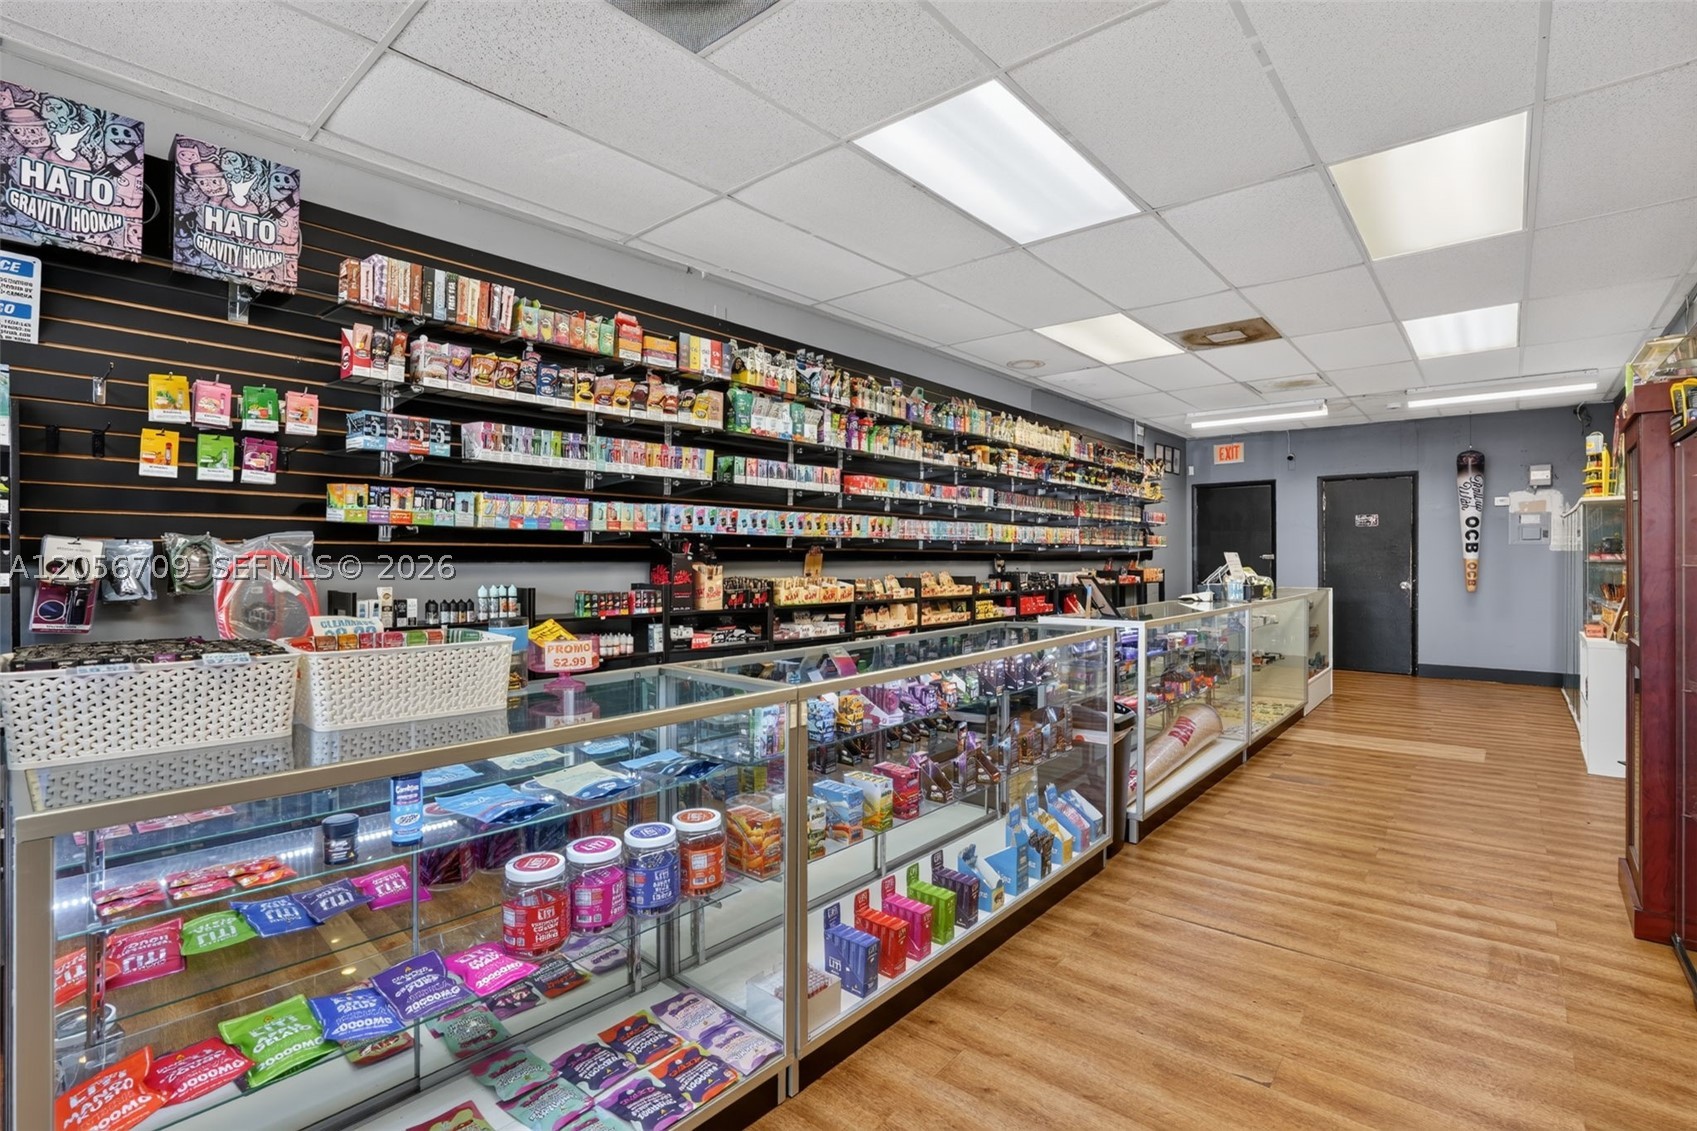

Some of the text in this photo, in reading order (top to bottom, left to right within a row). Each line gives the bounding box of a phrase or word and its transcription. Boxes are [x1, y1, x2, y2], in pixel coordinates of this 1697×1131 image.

[19, 158, 114, 205] HATO
[9, 190, 122, 234] GRAVITY HOOKAH
[204, 206, 277, 244] HATO
[195, 233, 283, 270] GRAVITY HOOKAH
[1219, 445, 1240, 461] EXIT
[1465, 516, 1480, 553] OCB
[1467, 562, 1477, 586] OCB
[547, 643, 591, 655] PROMO
[553, 656, 587, 668] $2.99
